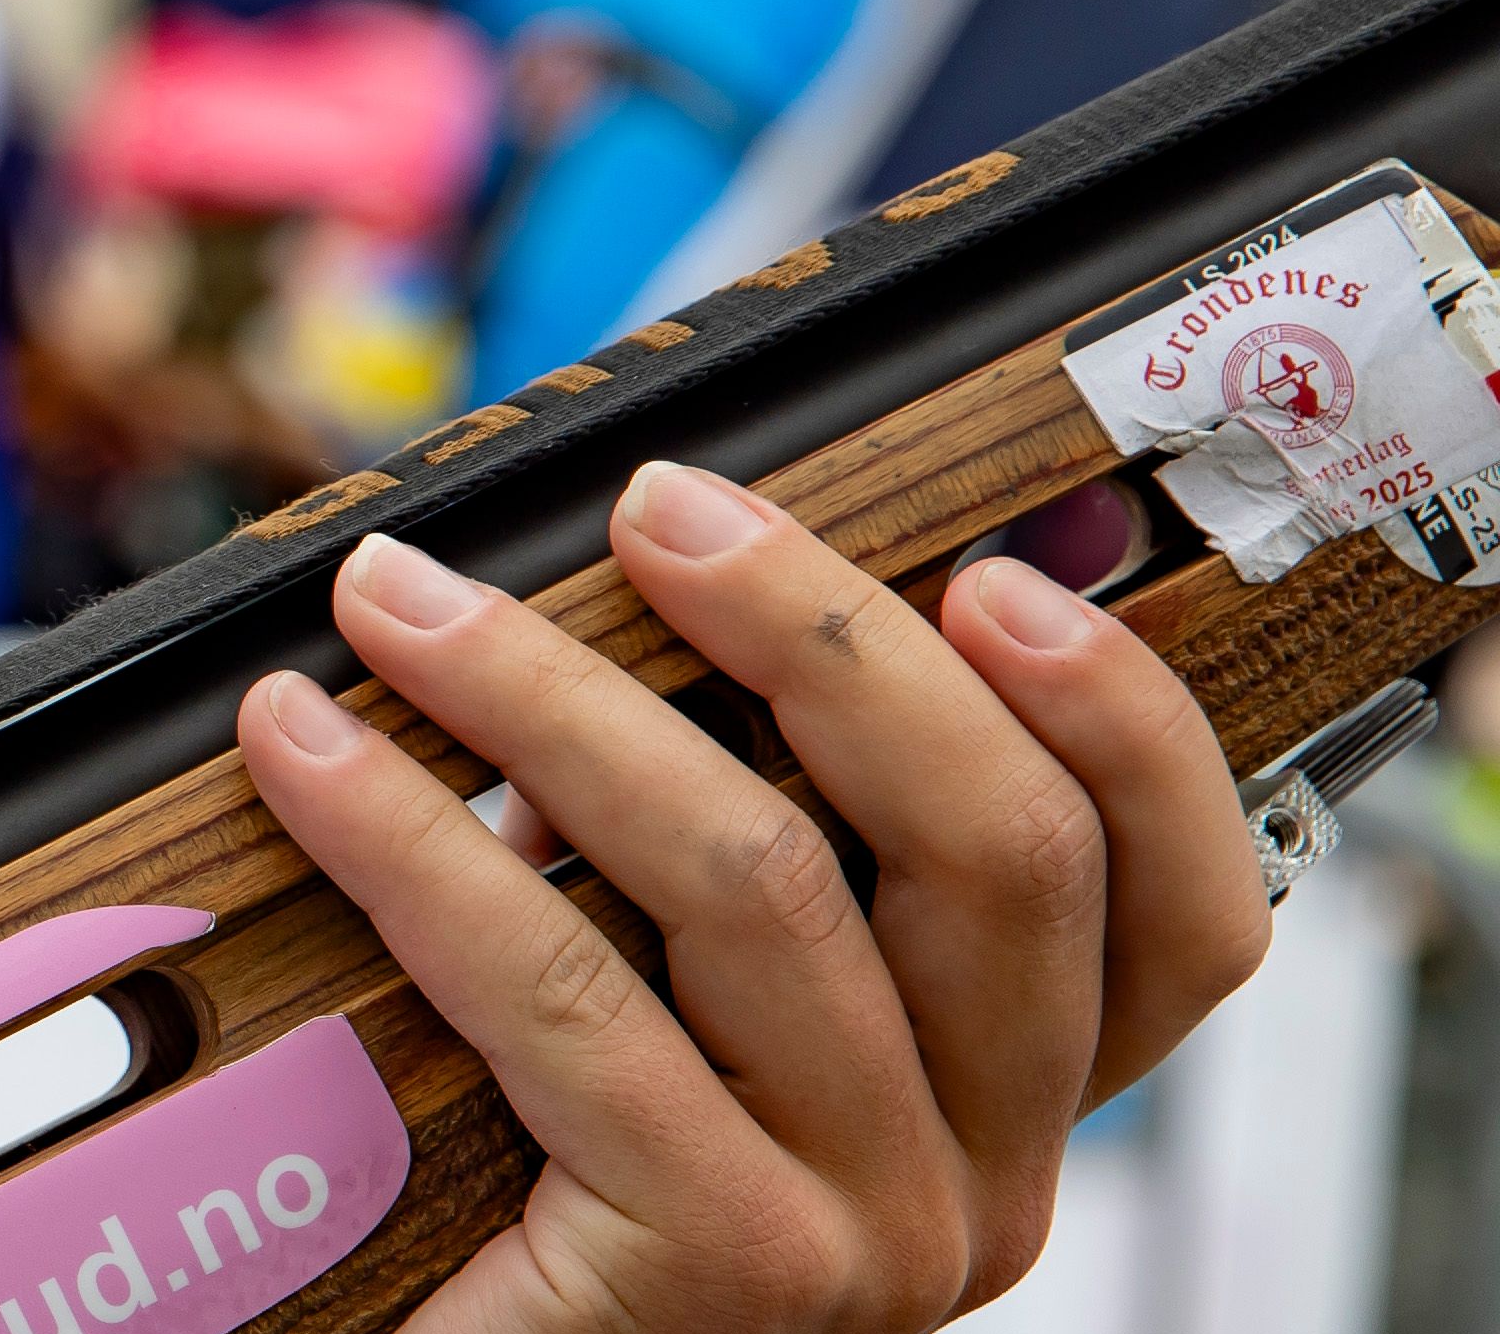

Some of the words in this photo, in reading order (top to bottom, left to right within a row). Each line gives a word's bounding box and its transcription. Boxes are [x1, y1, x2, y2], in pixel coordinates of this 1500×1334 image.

[1228, 224, 1298, 270] 2024
[1144, 268, 1369, 391] Trondenes
[1360, 461, 1435, 513] 2025
